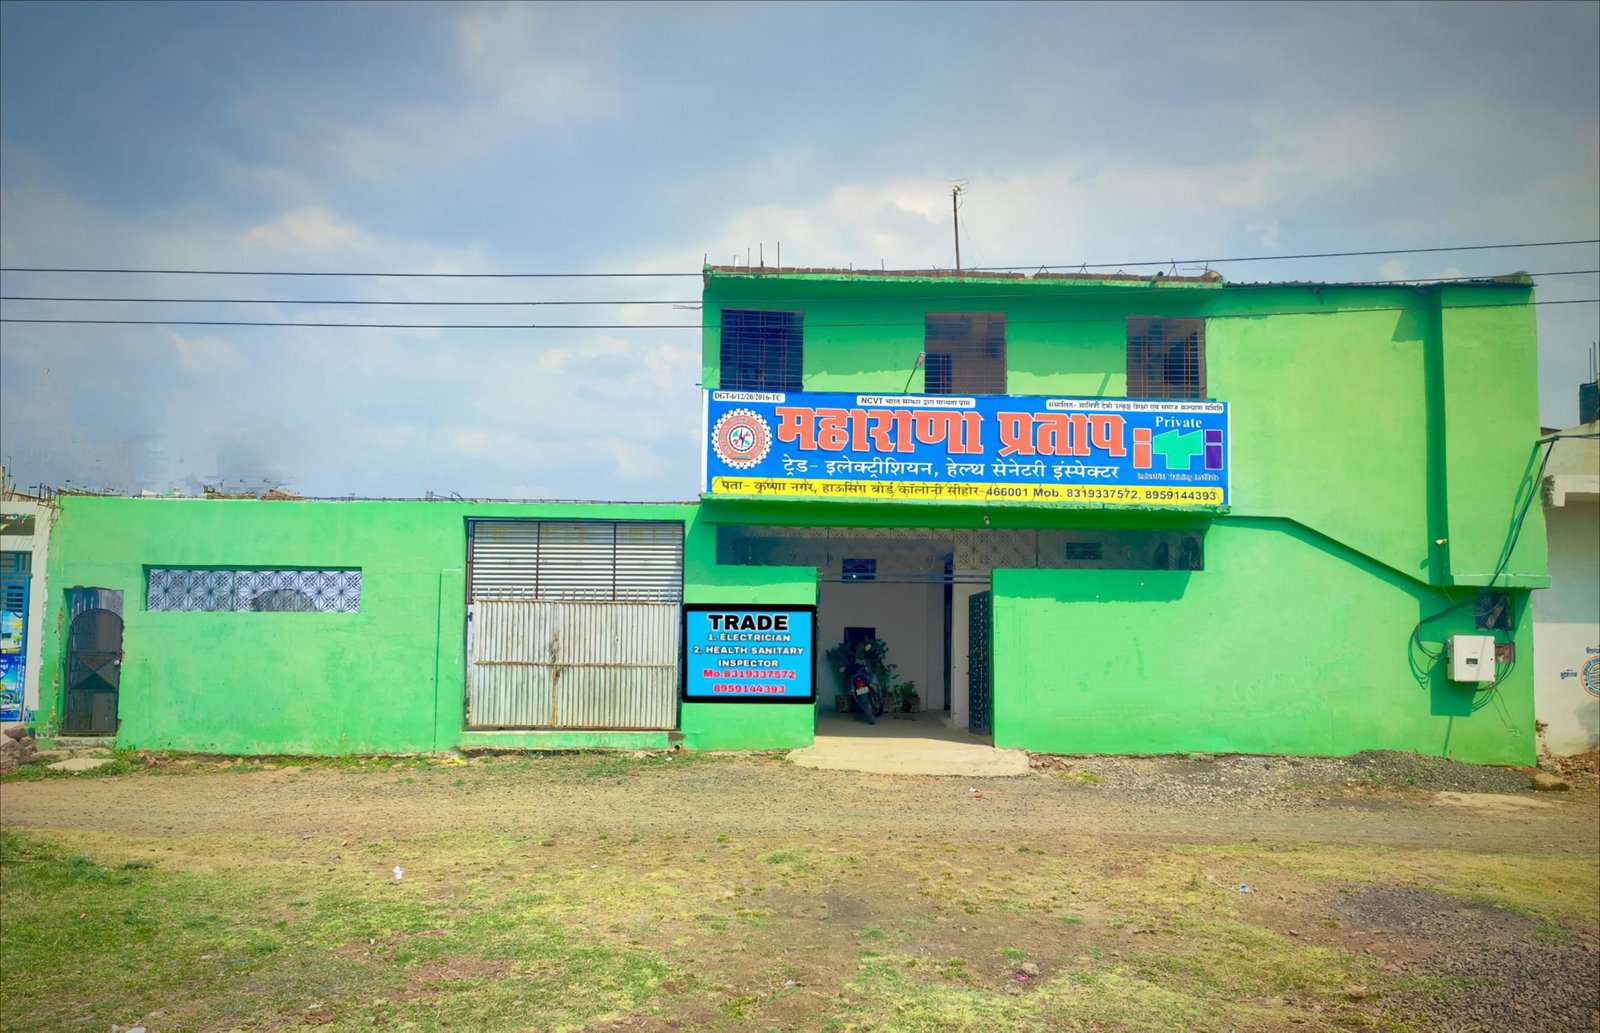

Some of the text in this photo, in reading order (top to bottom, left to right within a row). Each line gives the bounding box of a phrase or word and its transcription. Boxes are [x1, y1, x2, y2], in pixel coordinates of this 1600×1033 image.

[1155, 415, 1202, 428] Private
[775, 406, 984, 455] महाराणा
[997, 411, 1127, 457] प्रताप
[946, 457, 984, 477] हेल्थ
[991, 458, 1046, 479] सेनेटरी
[1052, 460, 1120, 481] इंस्पेक्टर
[1033, 487, 1063, 498] Mob.
[1066, 488, 1142, 501] 8319337572,
[1145, 490, 1217, 502] 8959144393
[708, 614, 789, 632] TRADE
[719, 633, 791, 642] ELECTRICIAN
[706, 646, 748, 655] HEALTH
[751, 647, 804, 655] SANITARY
[718, 659, 779, 668] INSPECTOR
